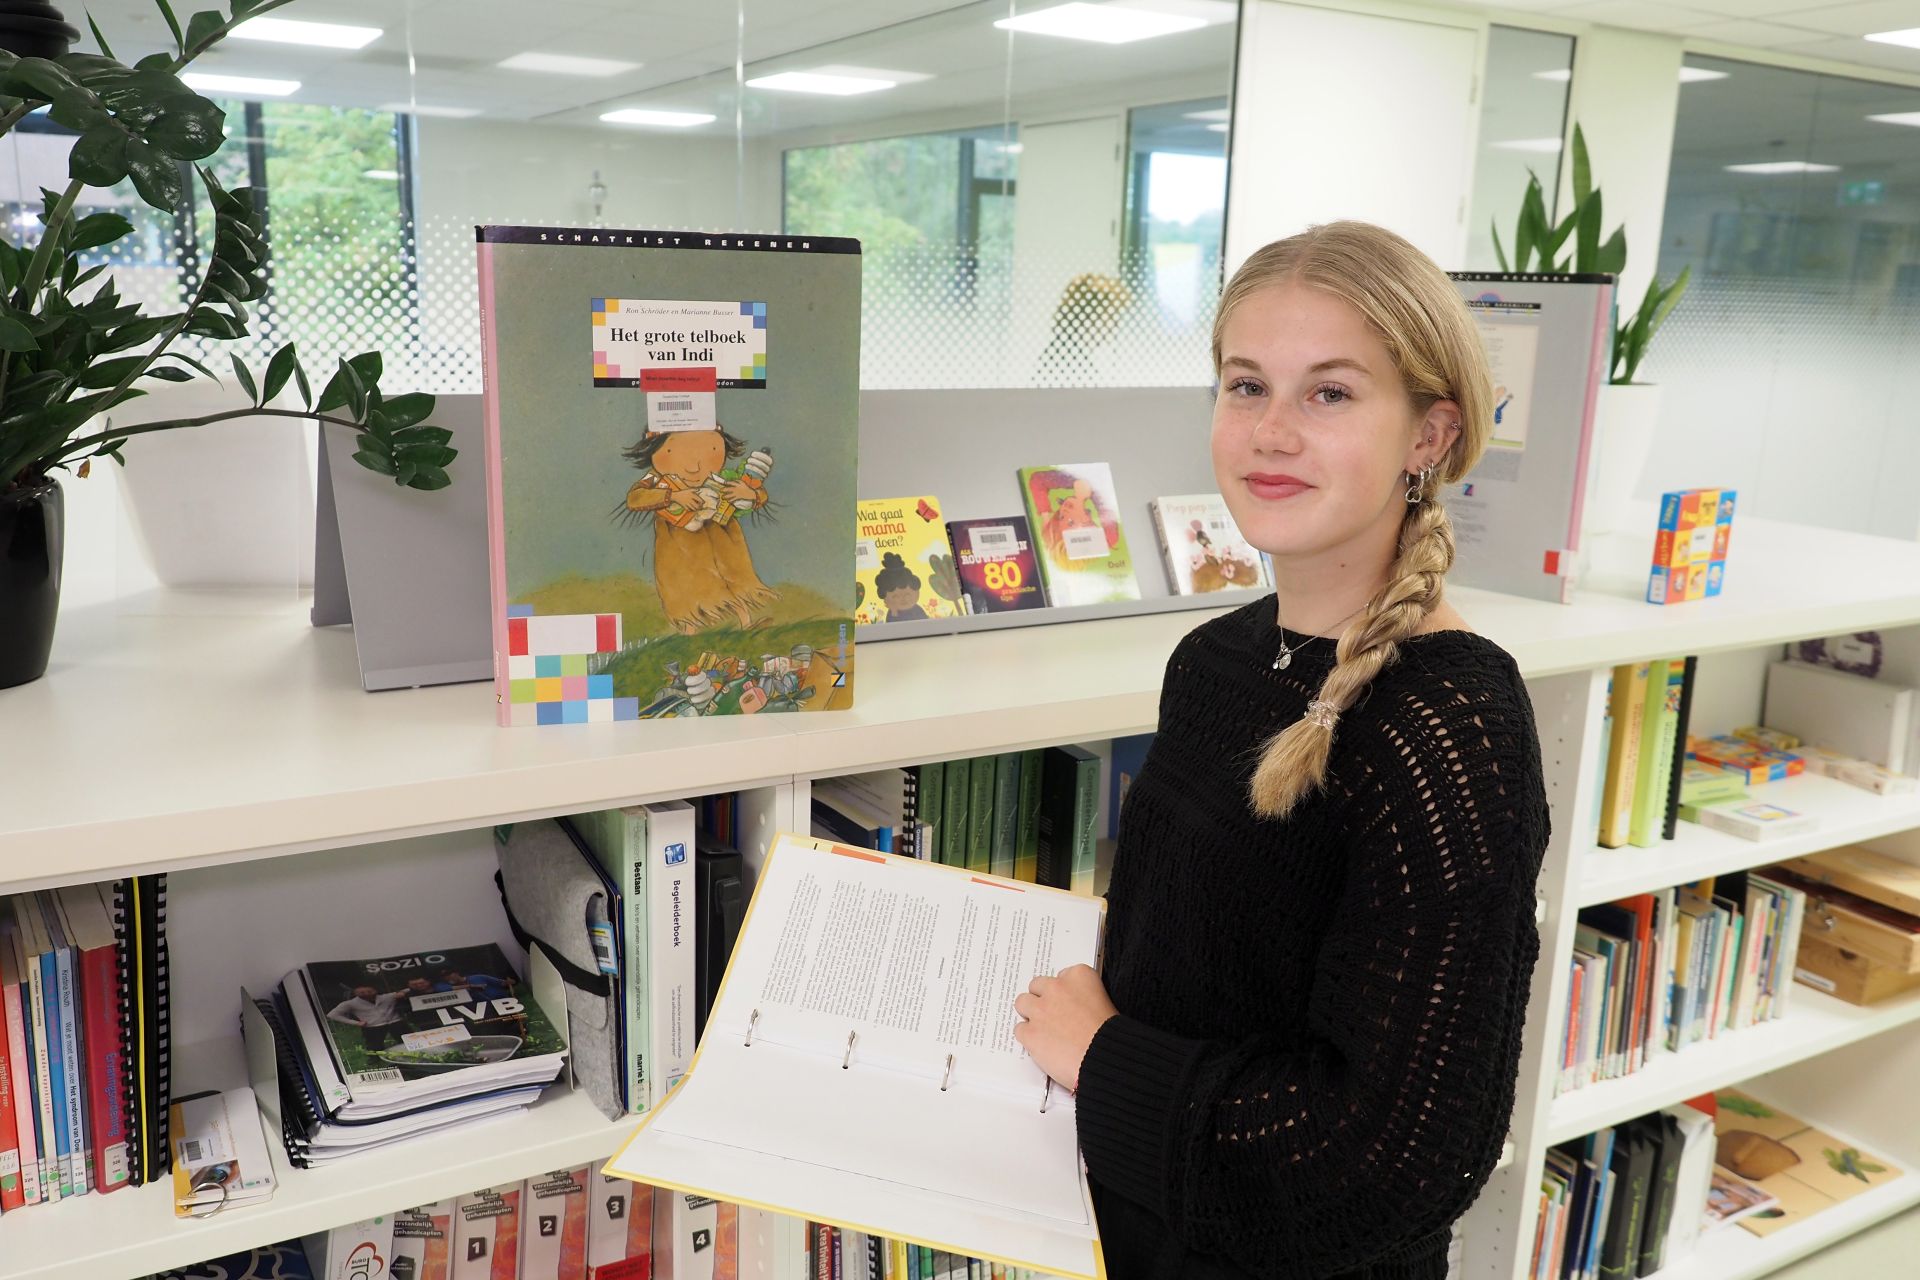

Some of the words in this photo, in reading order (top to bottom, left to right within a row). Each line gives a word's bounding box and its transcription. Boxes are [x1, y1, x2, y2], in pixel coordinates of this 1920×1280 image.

[540, 233, 681, 246] SCHATKIST
[704, 239, 811, 249] REKENEN
[680, 308, 711, 316] Marianne
[610, 327, 638, 342] Het
[644, 330, 685, 346] grote
[690, 329, 746, 344] telboek
[648, 350, 676, 361] van
[681, 347, 714, 362] Indi
[862, 522, 907, 537] mama
[874, 535, 904, 549] doen?
[983, 561, 1022, 590] 80
[634, 861, 643, 896] Bestaan
[672, 879, 681, 948] Begeleiderboek
[365, 954, 446, 974] SOZIO
[61, 969, 70, 991] Kristina
[435, 997, 525, 1026] LVB
[66, 1039, 74, 1054] moet
[69, 1085, 78, 1097] Het
[70, 1097, 80, 1127] syndroom
[73, 1138, 82, 1153] Dow
[533, 1178, 573, 1190] verstandelijk
[536, 1186, 582, 1198] gehandicapten
[463, 1200, 503, 1211] verstandelijk
[466, 1207, 512, 1219] gehandicapten
[610, 1201, 620, 1214] 3
[395, 1221, 433, 1229] erstandelijk
[542, 1219, 553, 1232] 2
[394, 1229, 442, 1237] gehandicapten
[695, 1233, 706, 1246] 4
[471, 1241, 481, 1255] 1
[818, 1226, 830, 1274] Creativiteit
